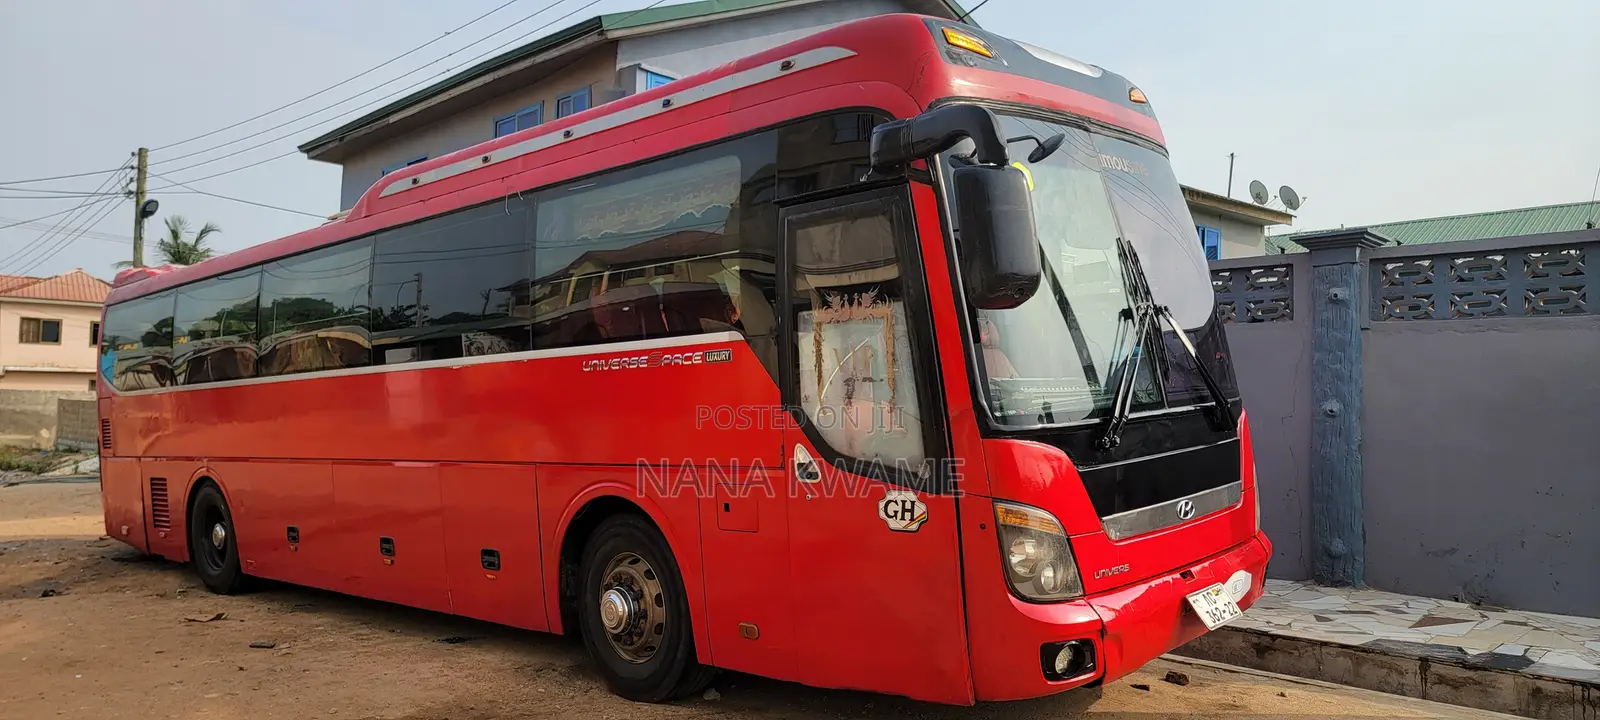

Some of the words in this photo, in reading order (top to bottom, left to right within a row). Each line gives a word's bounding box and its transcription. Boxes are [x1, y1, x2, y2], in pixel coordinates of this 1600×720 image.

[705, 350, 731, 363] LUXURY
[883, 498, 917, 523] GH
[1094, 563, 1130, 579] UNIVERS
[1202, 591, 1217, 608] AC
[1205, 601, 1238, 624] 362-22
